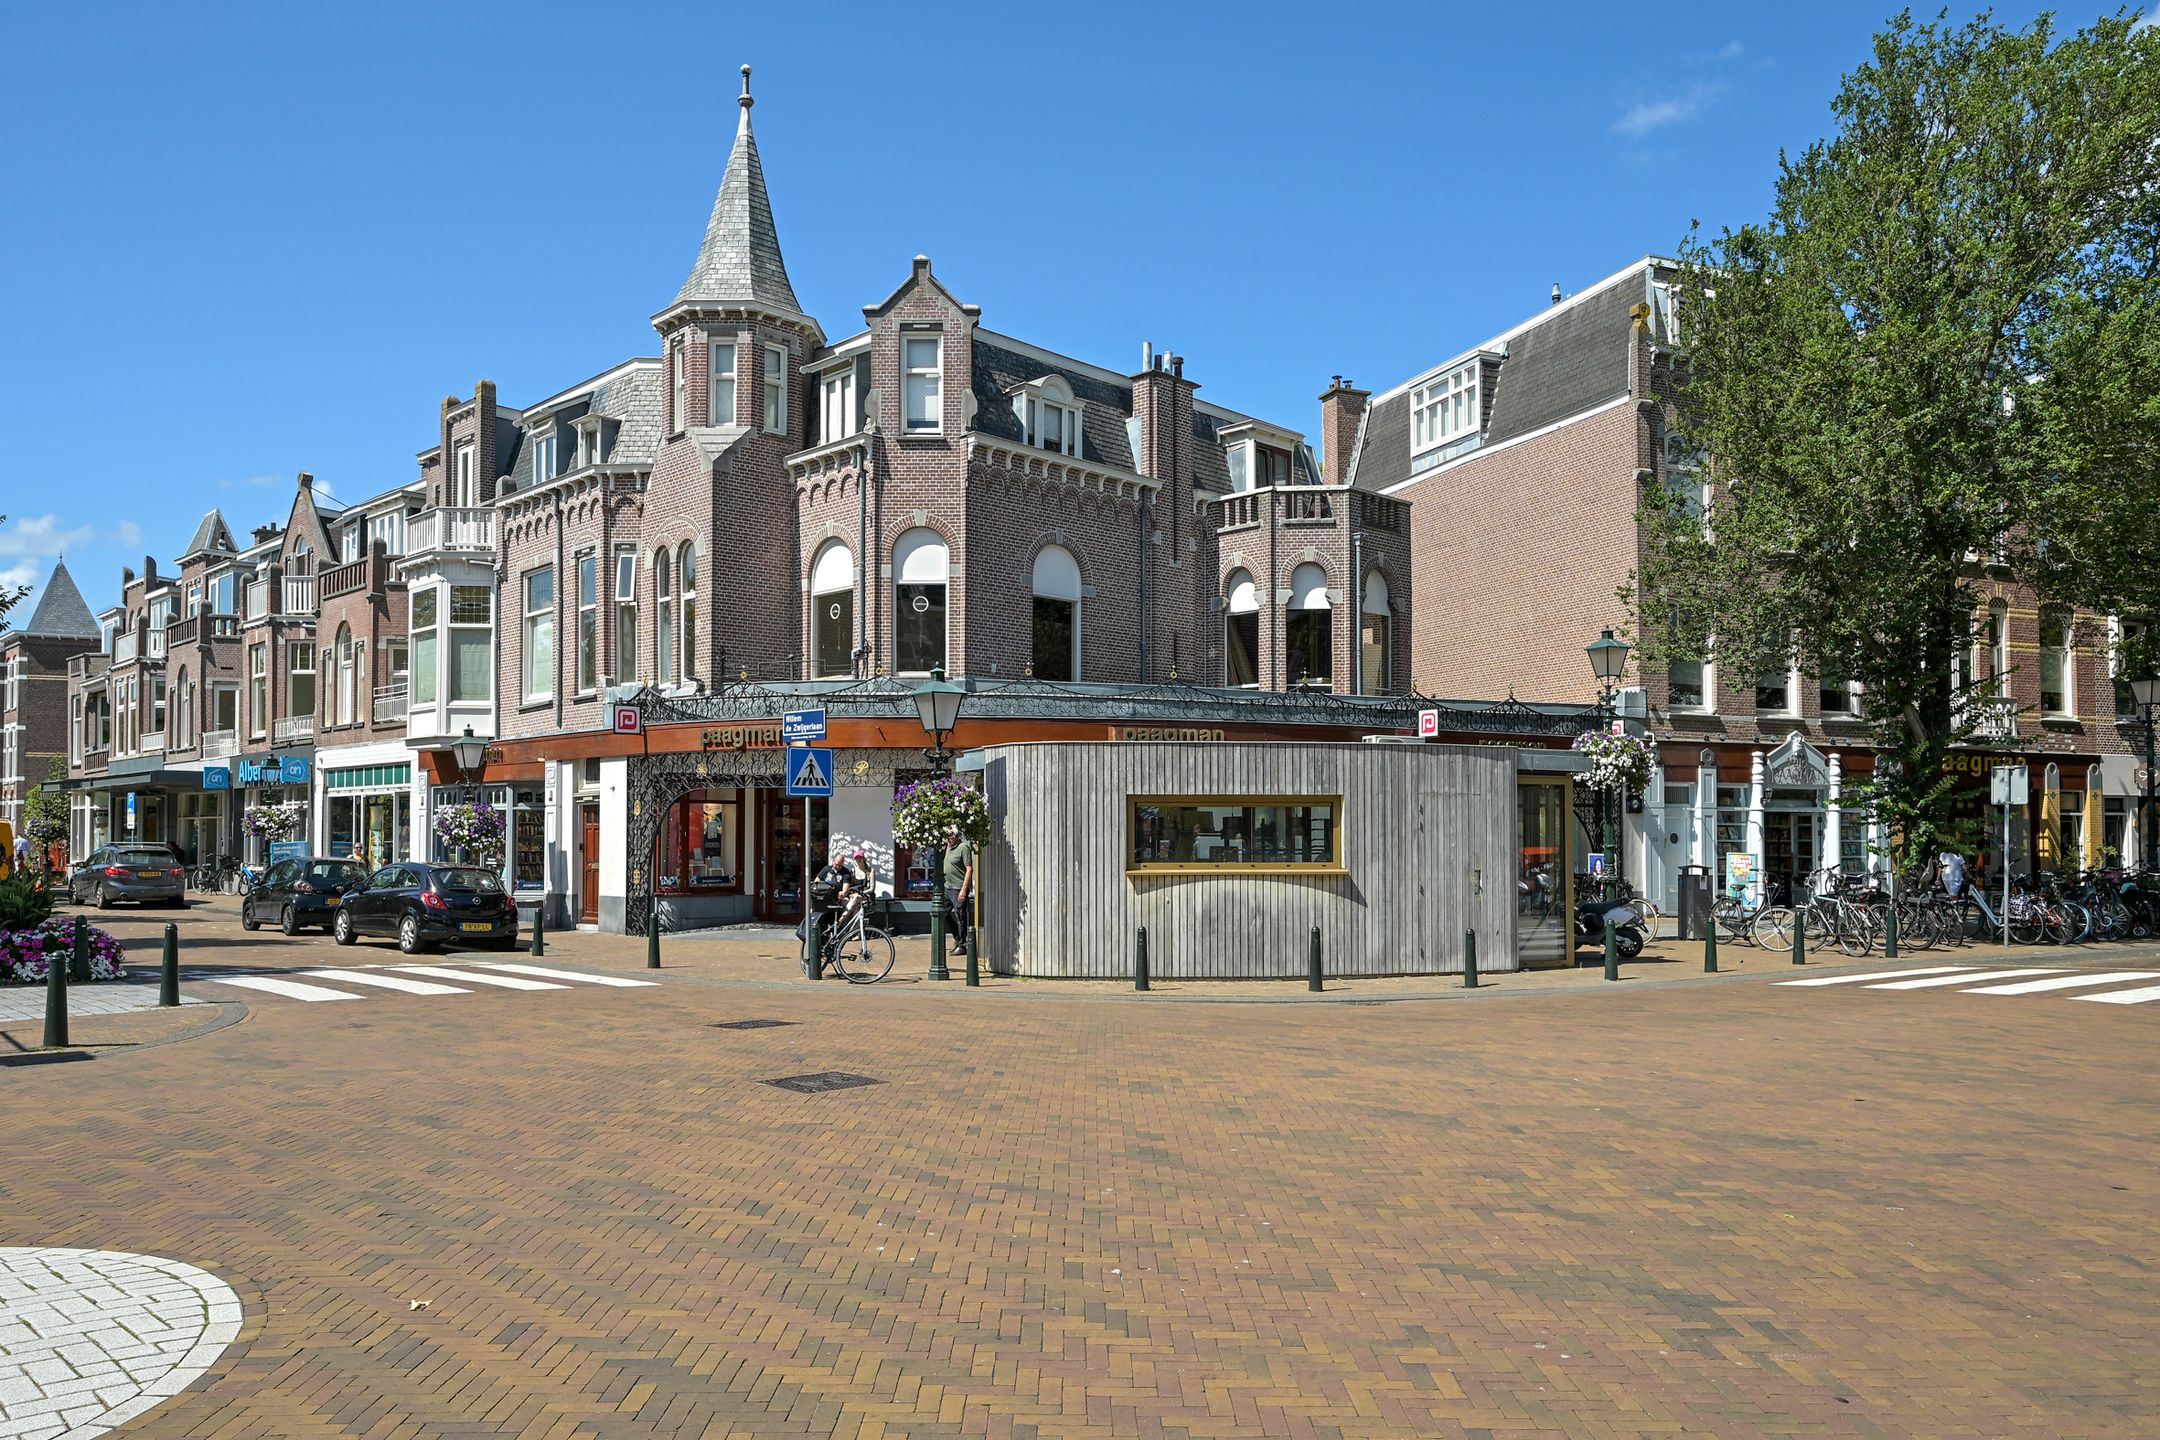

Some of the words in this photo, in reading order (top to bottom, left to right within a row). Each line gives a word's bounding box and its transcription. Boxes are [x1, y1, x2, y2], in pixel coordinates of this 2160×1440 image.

[786, 715, 802, 723] Willem
[786, 724, 792, 732] de
[793, 723, 823, 733] Zwijgerlaan
[1941, 754, 2027, 777] aagman
